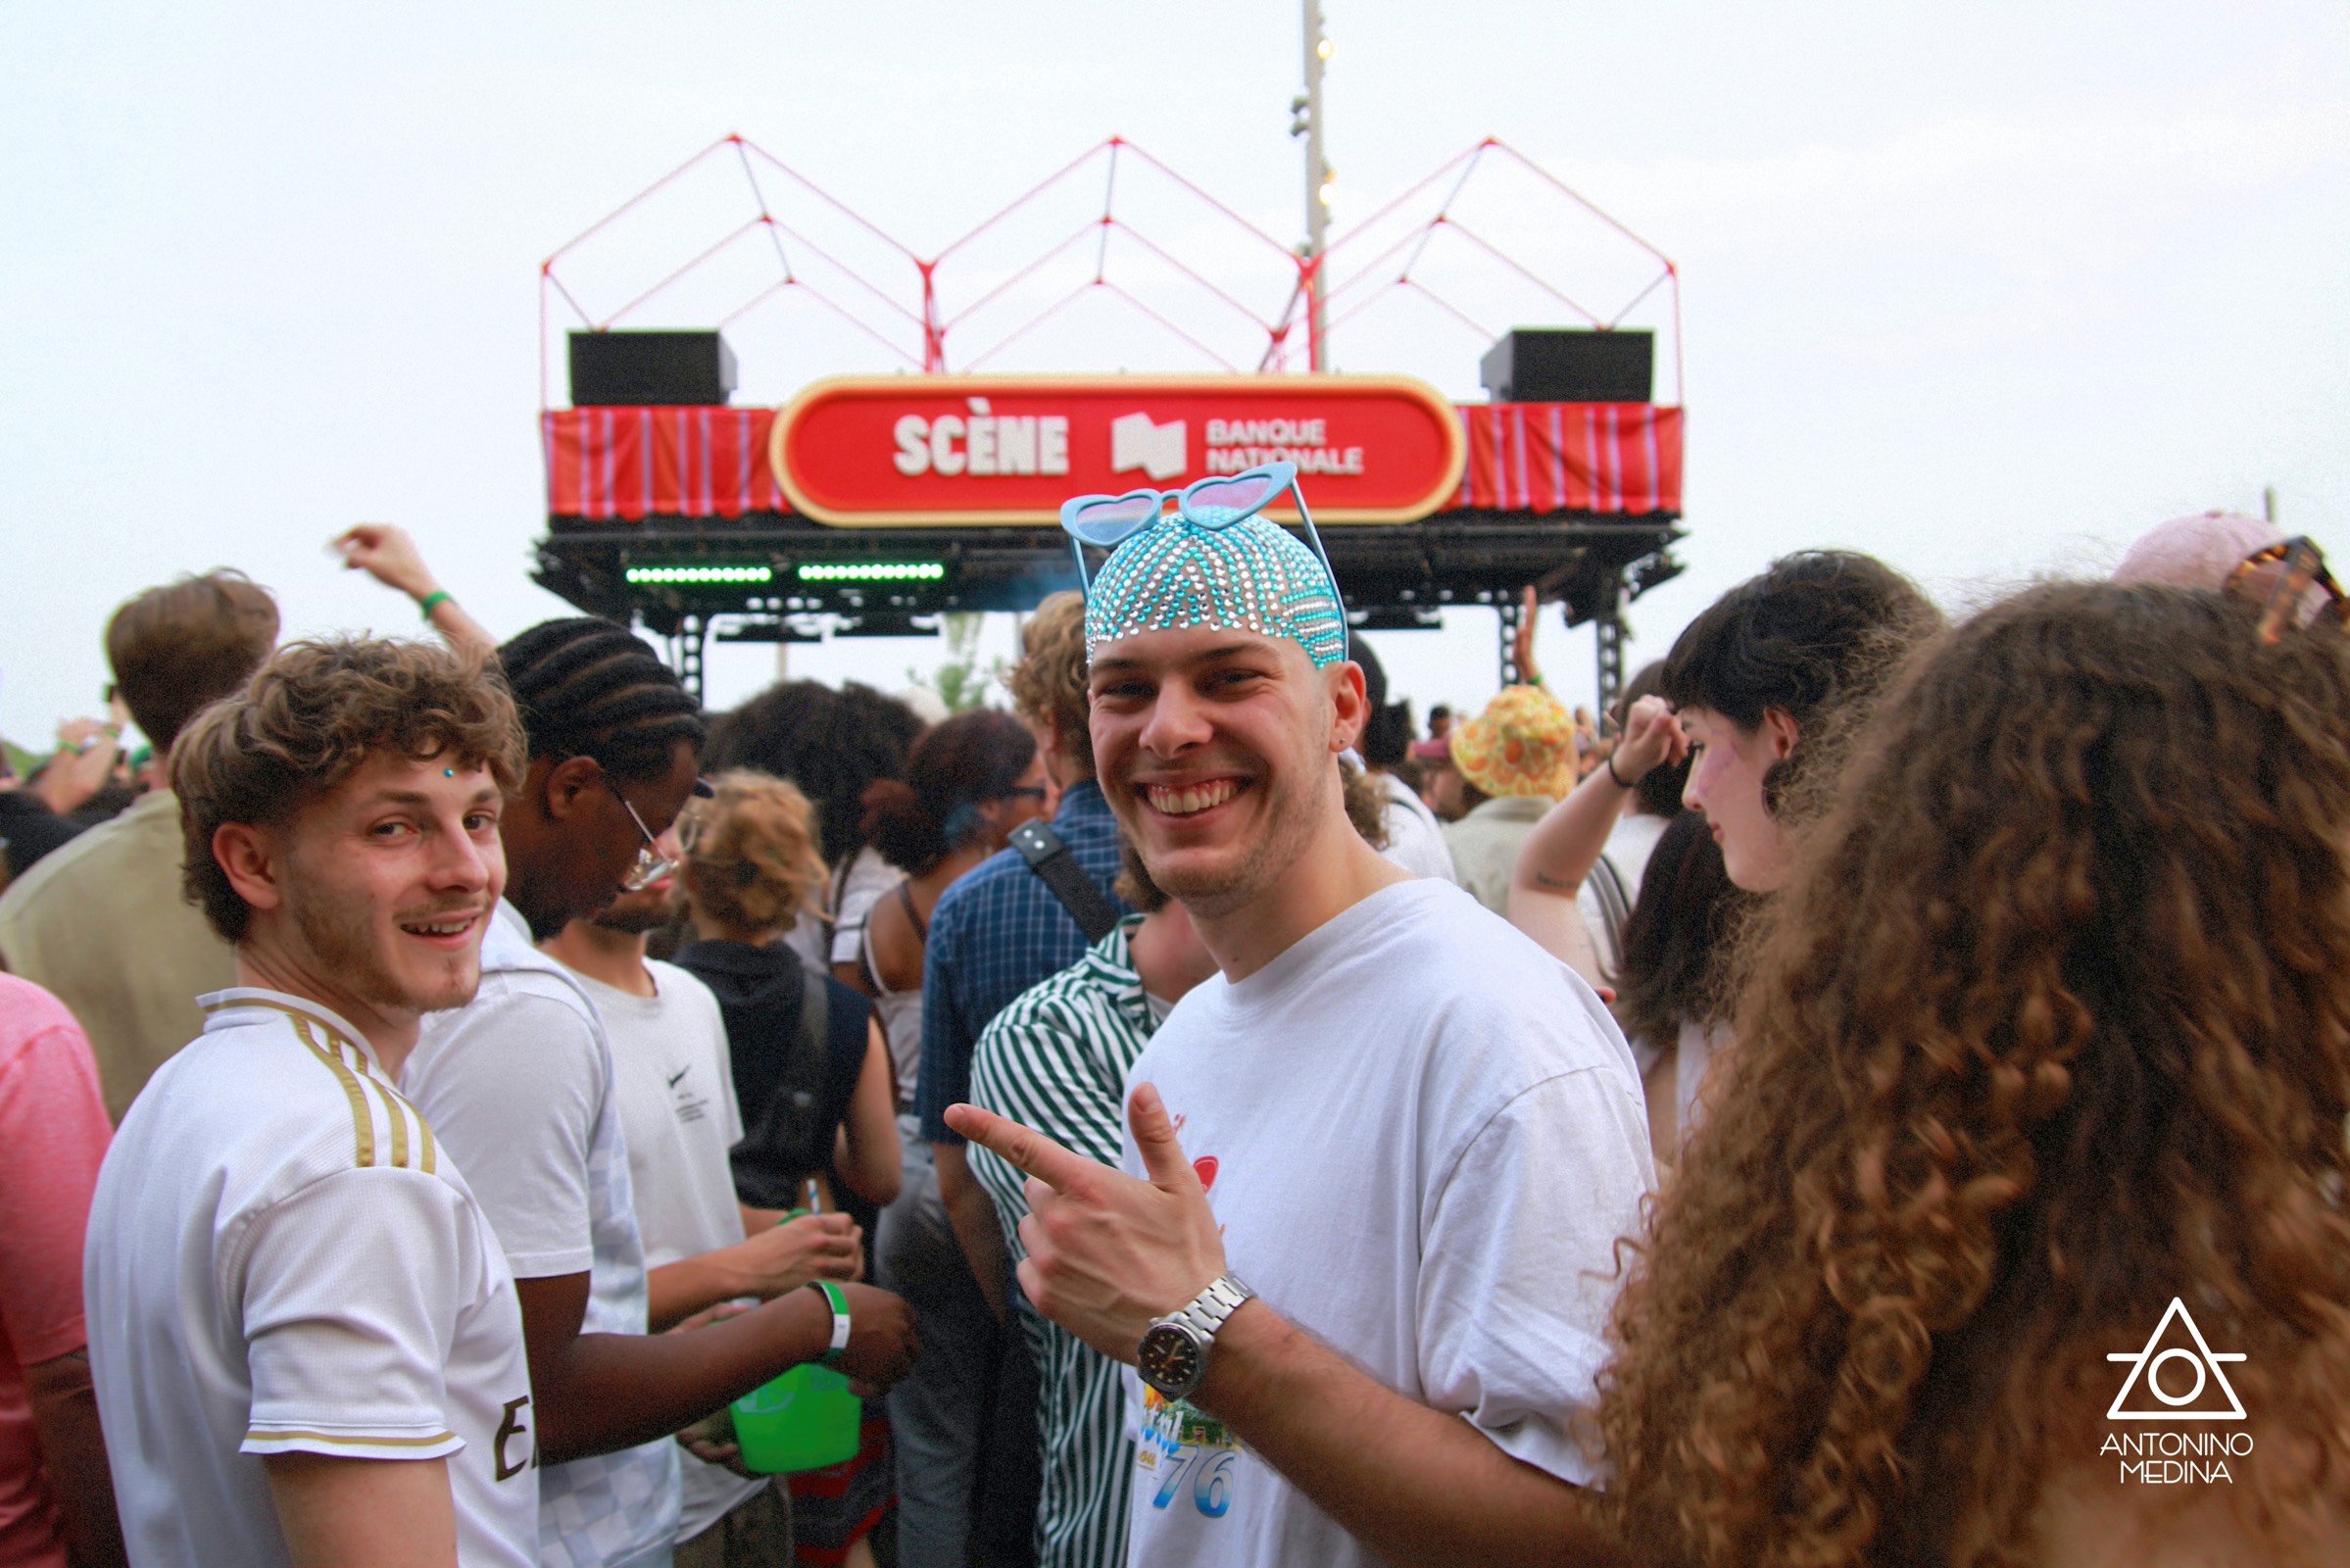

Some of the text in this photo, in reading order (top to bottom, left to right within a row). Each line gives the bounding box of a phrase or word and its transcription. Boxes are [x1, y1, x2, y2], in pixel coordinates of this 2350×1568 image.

[894, 396, 1069, 476] SCÈNE
[1206, 418, 1326, 447] BANQUE
[494, 1395, 538, 1483] E
[1152, 1444, 1236, 1519] 76
